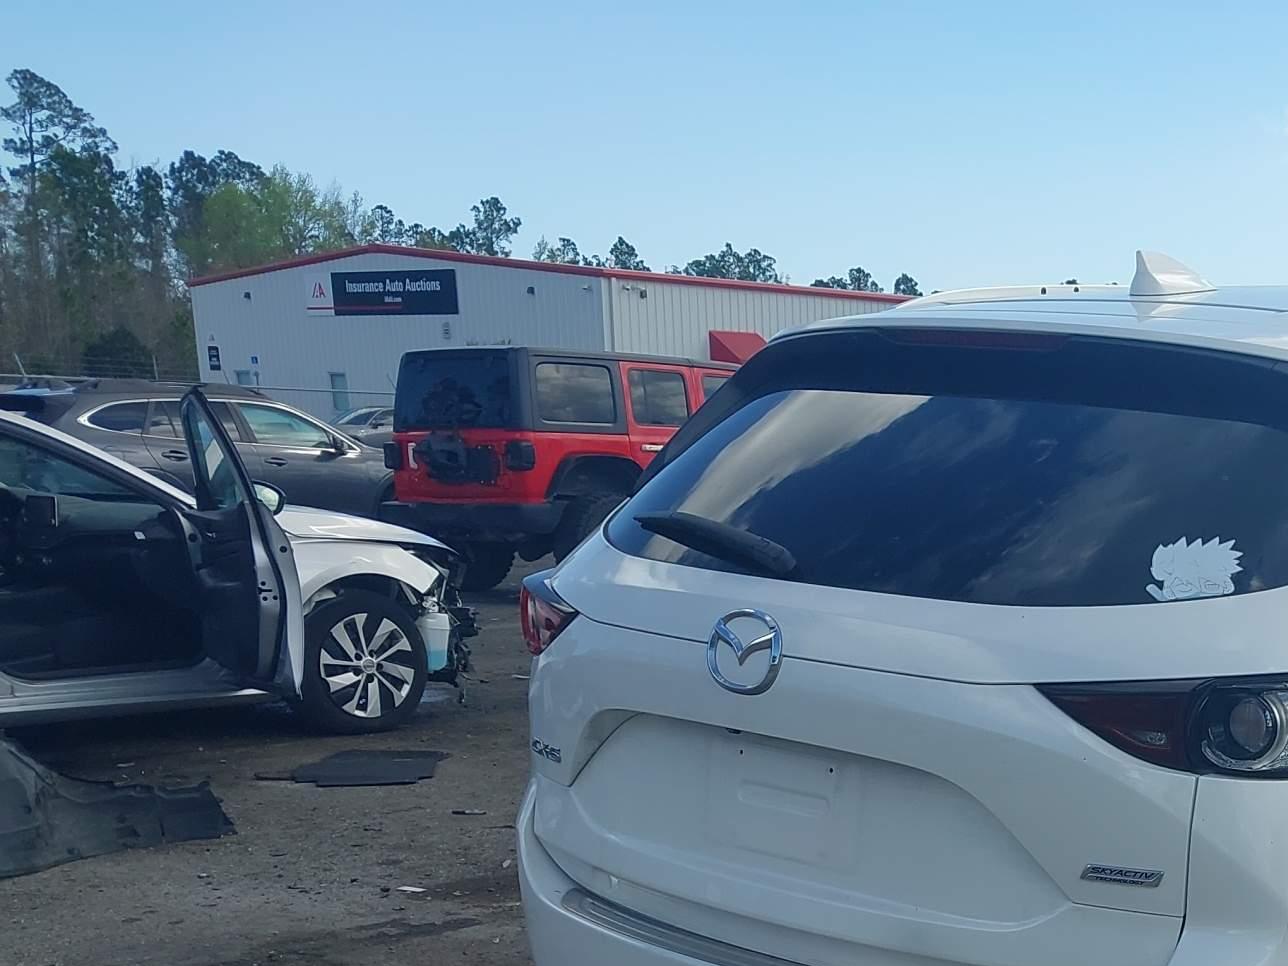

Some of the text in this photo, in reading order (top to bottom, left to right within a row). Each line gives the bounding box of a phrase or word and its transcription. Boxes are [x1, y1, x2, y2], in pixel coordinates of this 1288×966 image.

[345, 278, 441, 293] Insurance Auto Auctions
[1090, 866, 1158, 880] SKYACTIV
